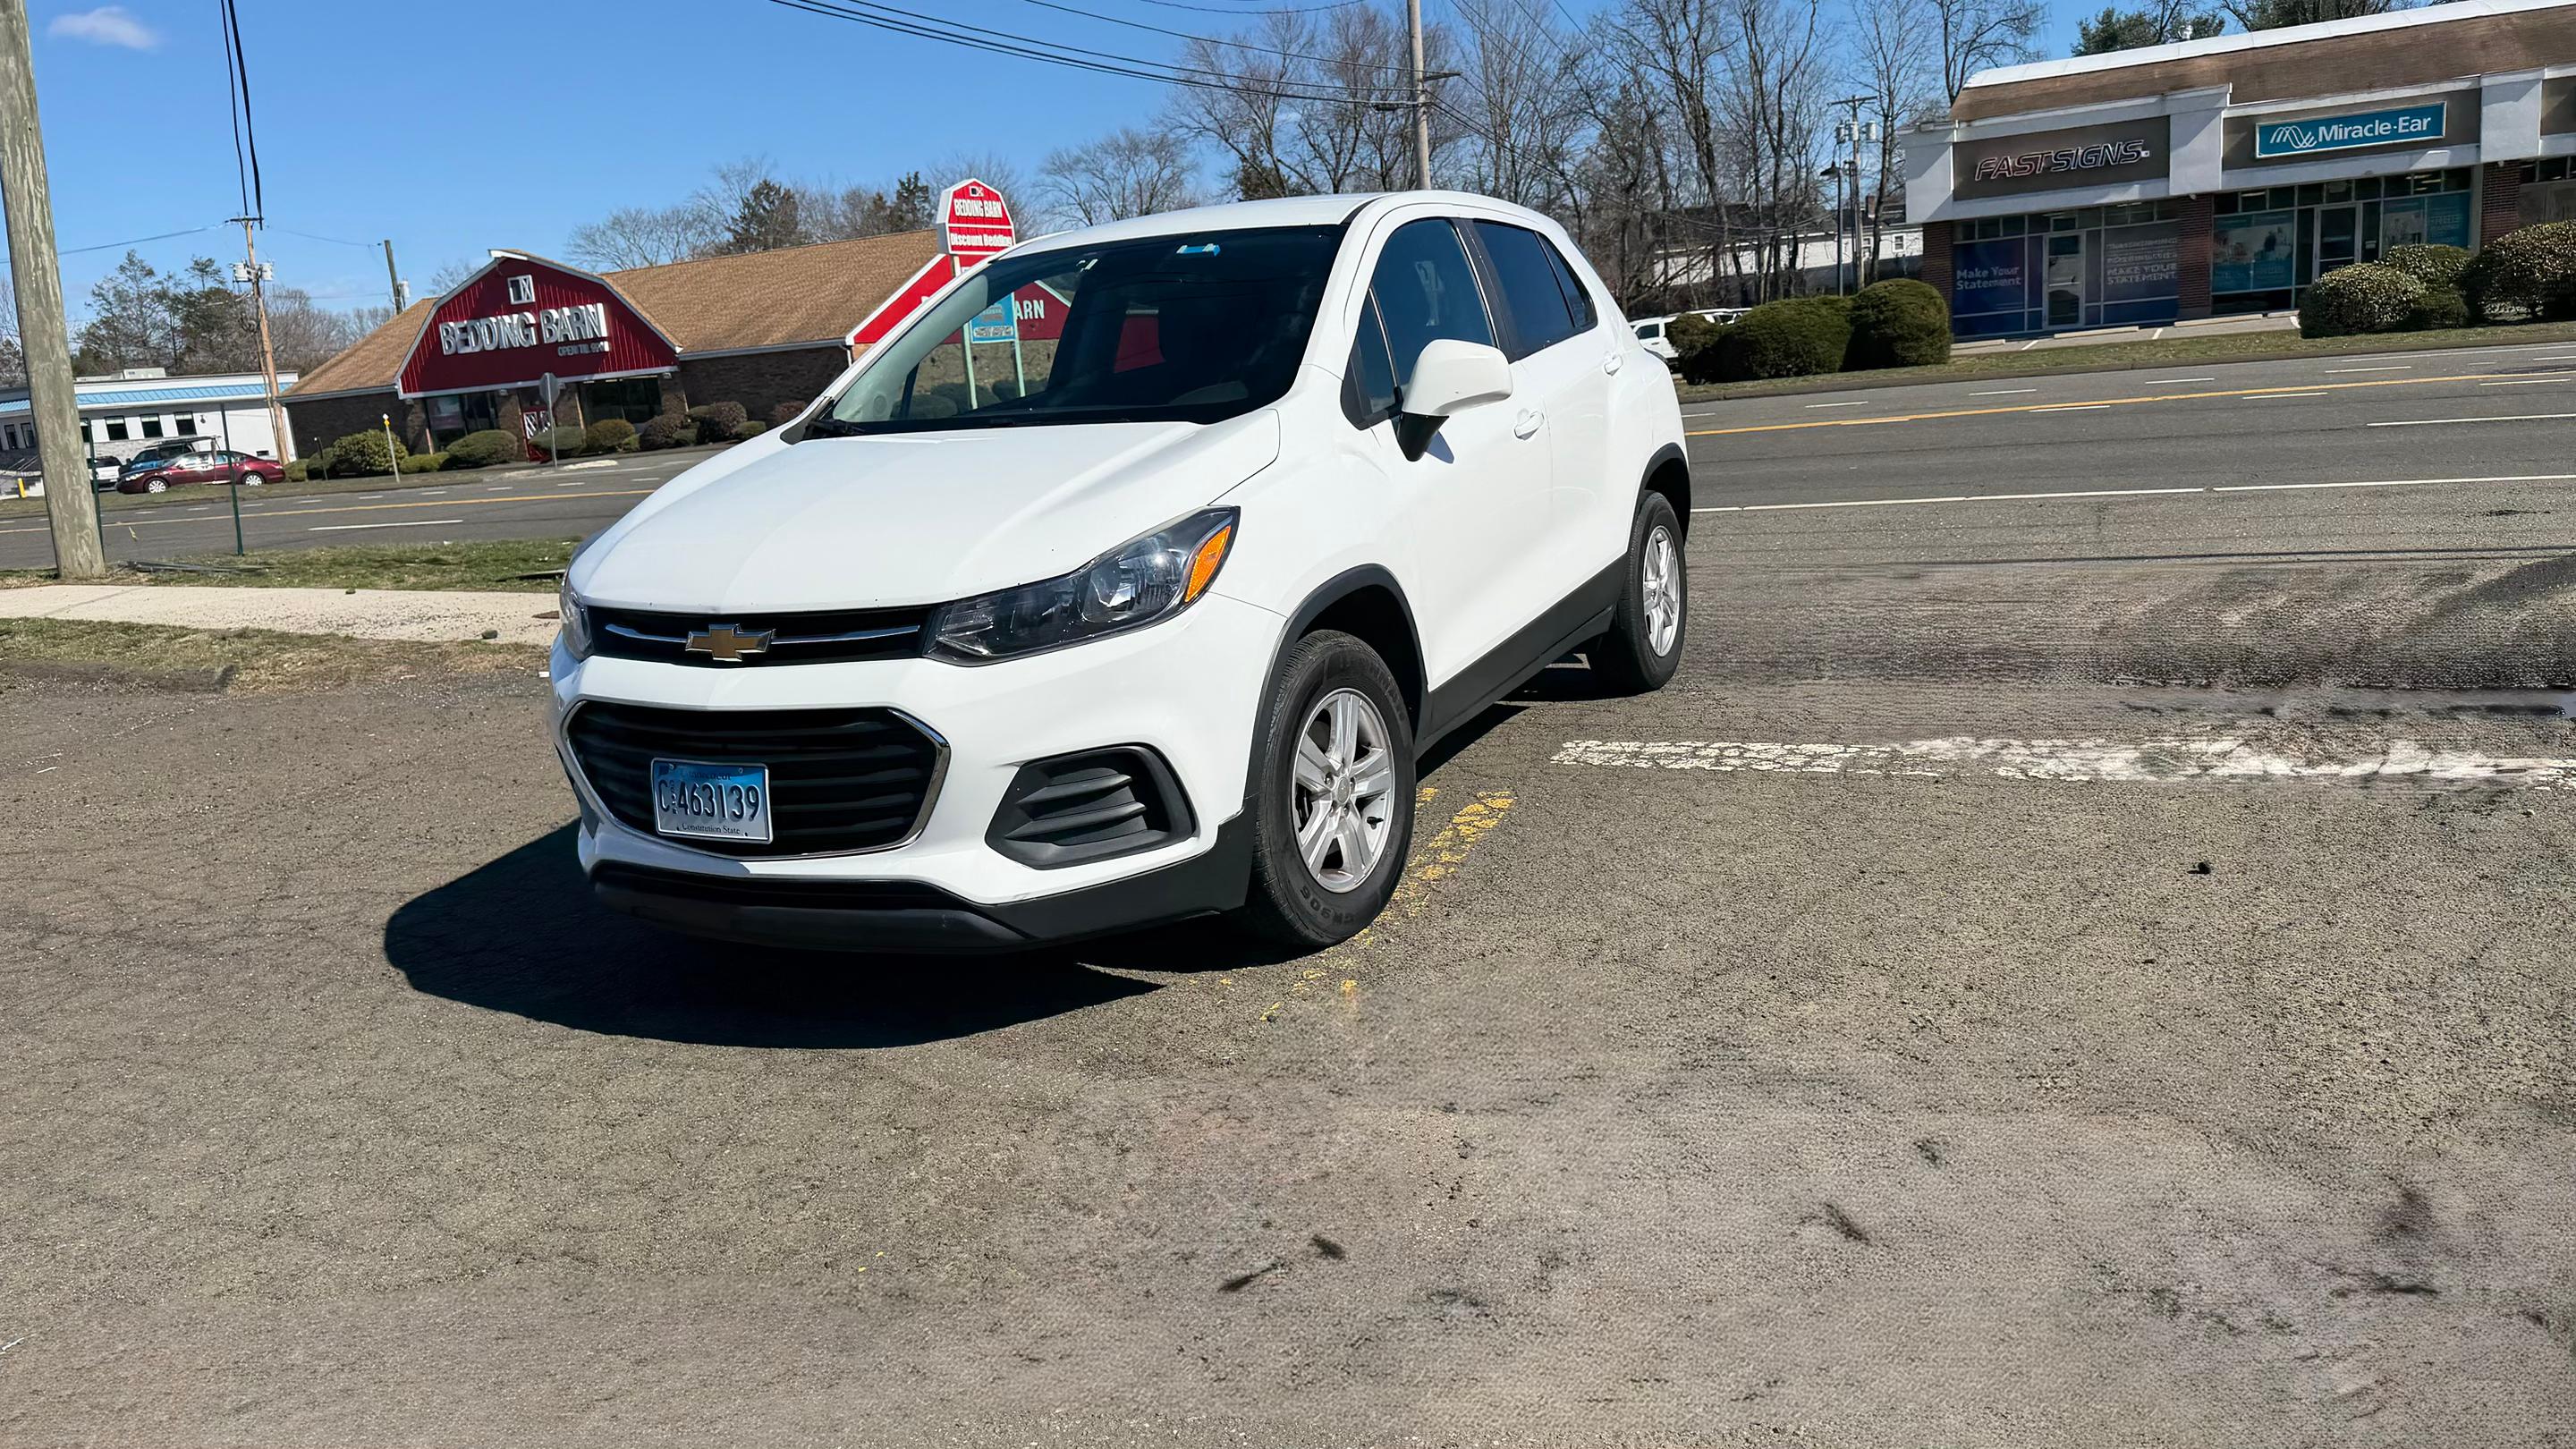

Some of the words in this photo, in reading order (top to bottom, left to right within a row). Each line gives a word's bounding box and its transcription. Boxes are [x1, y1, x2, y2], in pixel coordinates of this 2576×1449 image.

[1975, 140, 2146, 182] FASTSIGNS
[953, 199, 985, 217] BEDDING
[984, 199, 1003, 218] BARN
[950, 232, 984, 247] Discount
[1956, 267, 1989, 280] Make
[1990, 266, 2020, 276] Your
[1956, 276, 2021, 291] Statement
[1014, 300, 1045, 320] ARN
[439, 311, 537, 356] BEDDING
[539, 302, 608, 344] BARN
